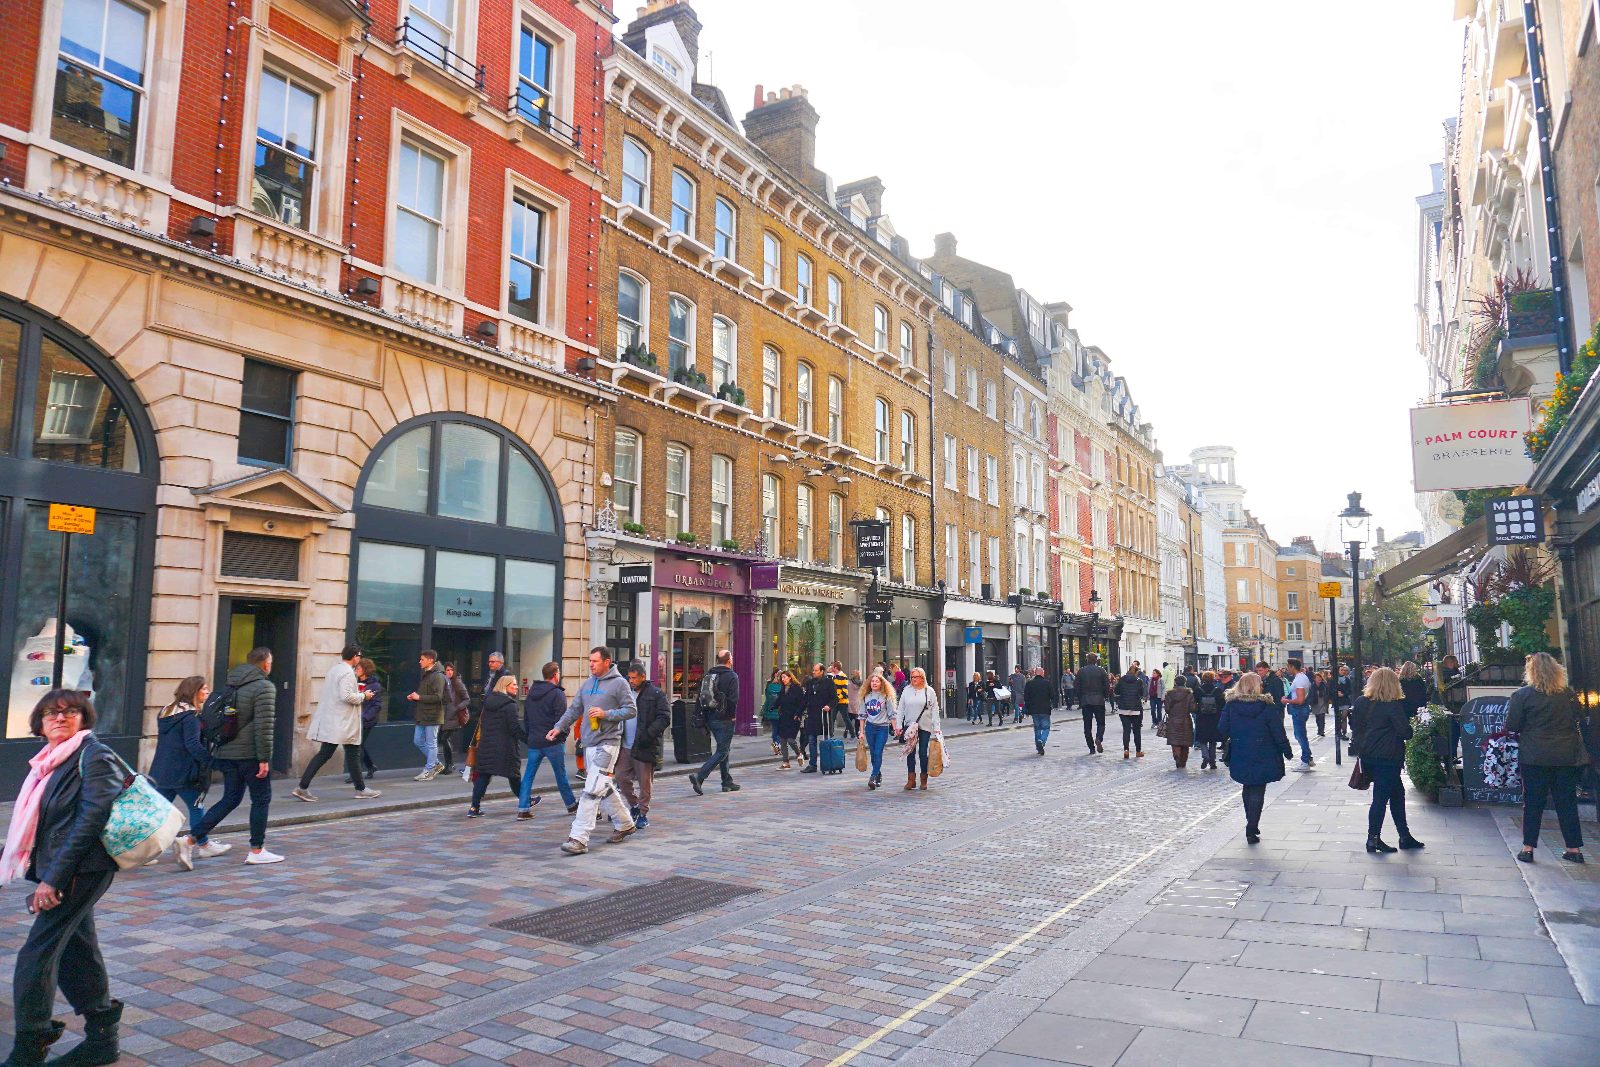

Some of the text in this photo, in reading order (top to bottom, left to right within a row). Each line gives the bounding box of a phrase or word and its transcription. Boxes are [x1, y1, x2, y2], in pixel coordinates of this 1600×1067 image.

[1425, 430, 1518, 445] PALM COURT
[1433, 448, 1512, 460] BRASSERIE
[621, 575, 648, 584] DOWNTOWN
[675, 574, 735, 589] URBAN DECAY
[779, 584, 811, 596] MONICA
[446, 609, 461, 618] King
